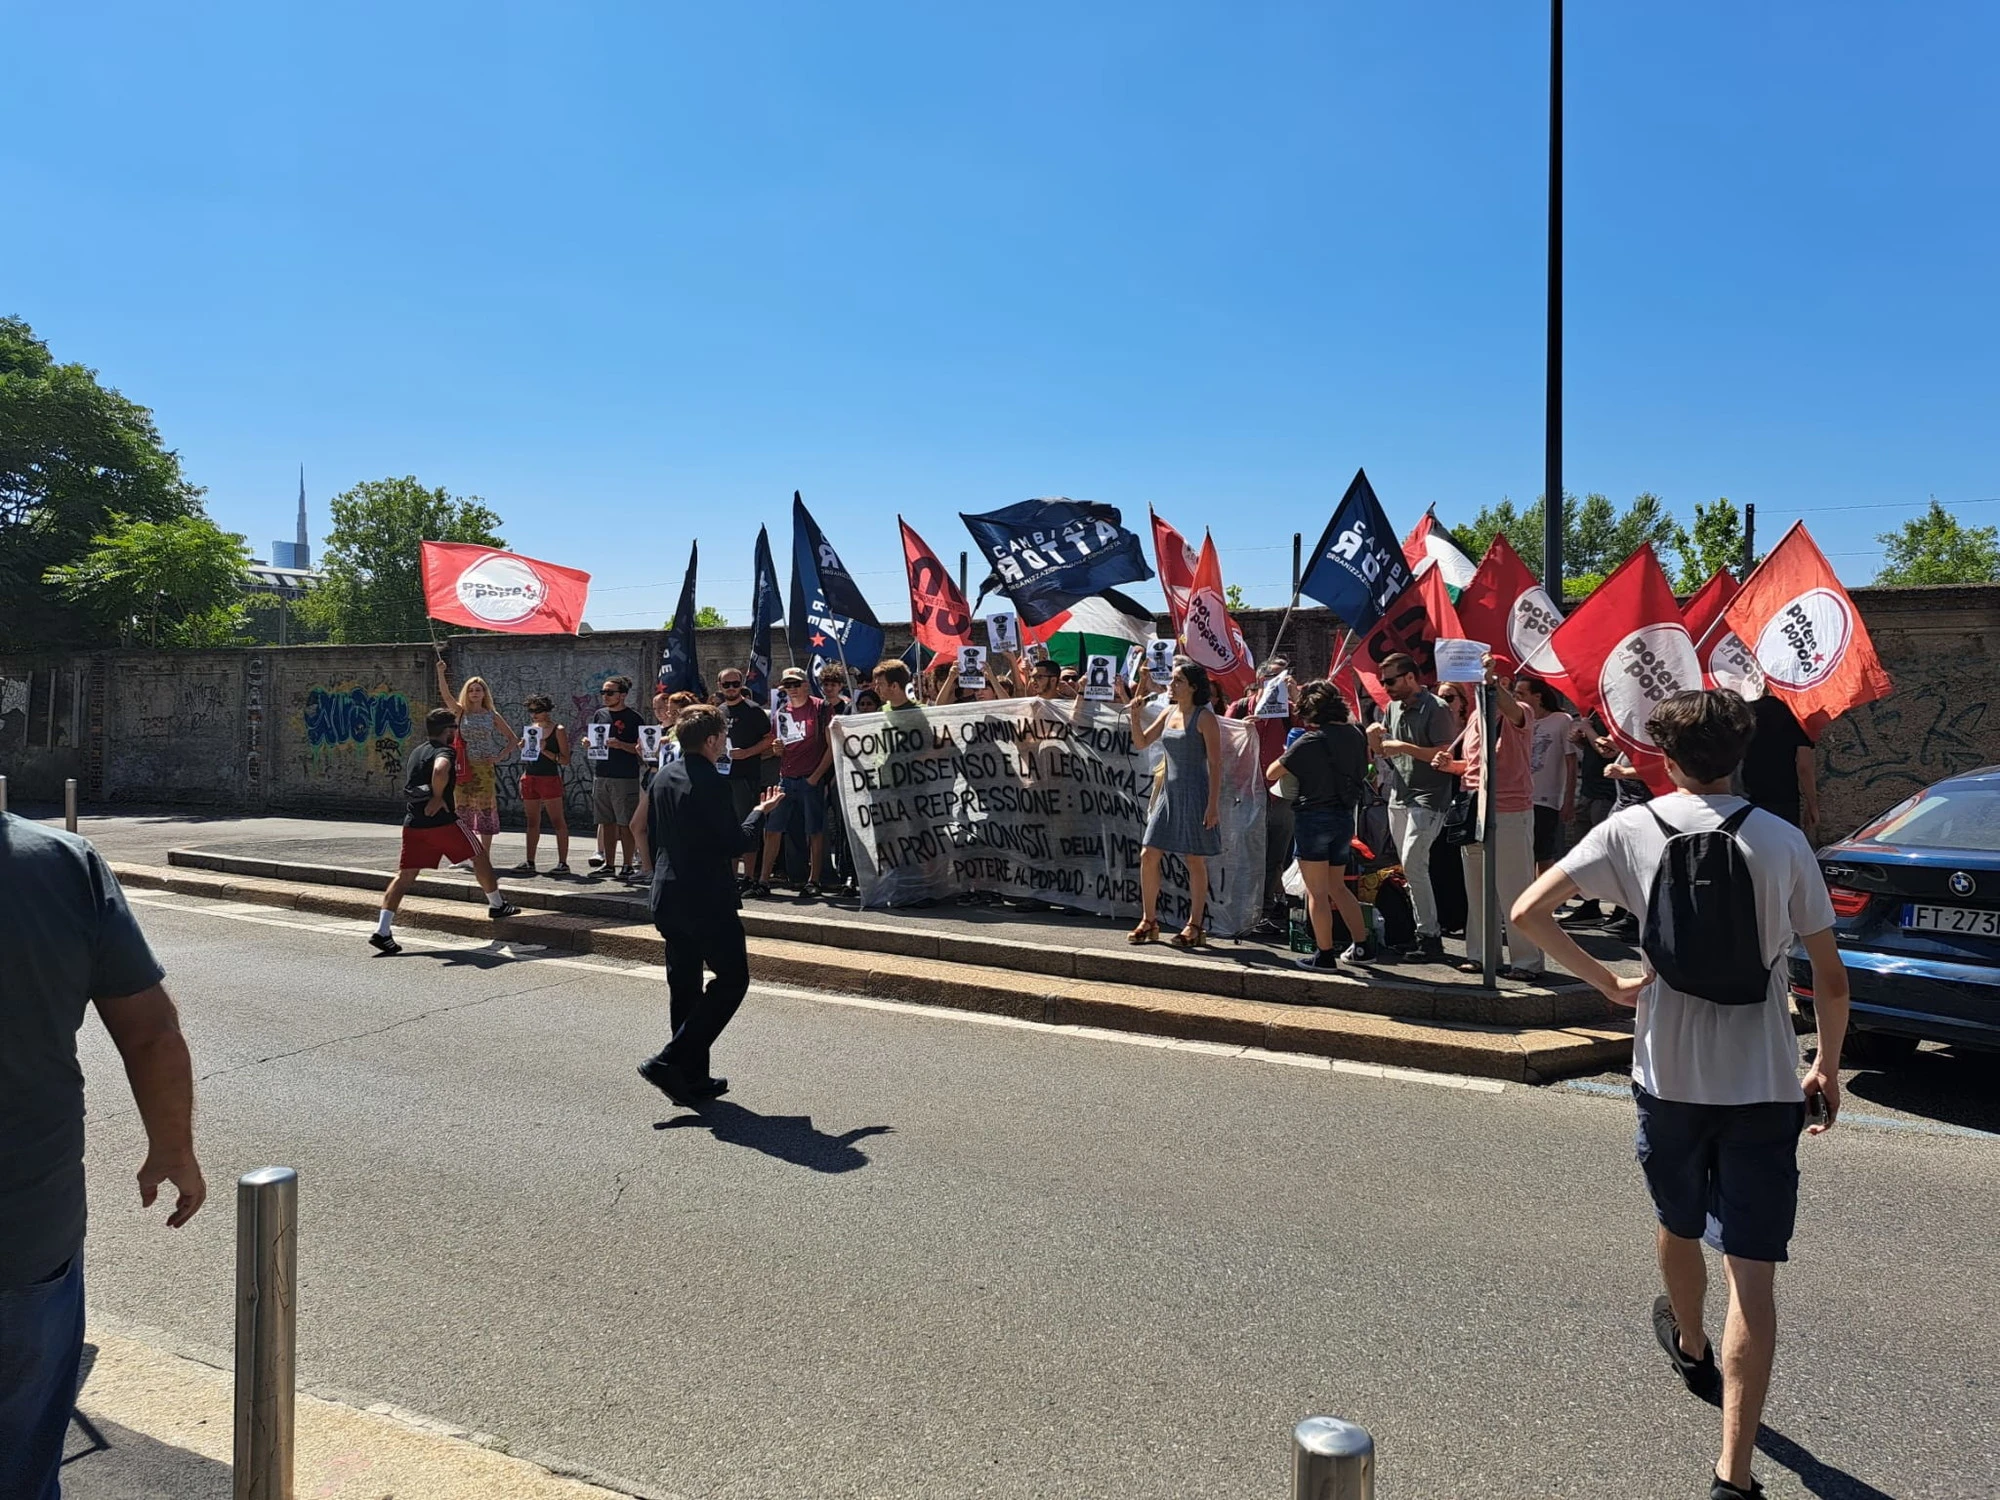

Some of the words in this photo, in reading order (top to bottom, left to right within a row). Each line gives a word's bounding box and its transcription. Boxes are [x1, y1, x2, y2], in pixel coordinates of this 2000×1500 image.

[1518, 599, 1560, 629] pote
[1626, 637, 1681, 693] poter
[1729, 652, 1762, 693] popo
[843, 726, 924, 760] CONTRO
[933, 724, 954, 750] LA
[961, 718, 1139, 756] CRIMINALIZZAZIONE
[851, 767, 890, 792] DEL
[891, 753, 997, 786] DISSENSO
[1002, 754, 1016, 777] E
[1019, 751, 1041, 781] LA
[1051, 752, 1154, 799] LEGITTIMAZ
[858, 802, 912, 828] DELLA
[877, 843, 899, 876] AI
[1060, 836, 1104, 858] DELLA
[953, 857, 1013, 883] POTERE
[1014, 866, 1029, 886] AL
[1029, 866, 1084, 895] POPOLO
[1916, 907, 1944, 928] FT
[1951, 910, 2000, 935] 273
